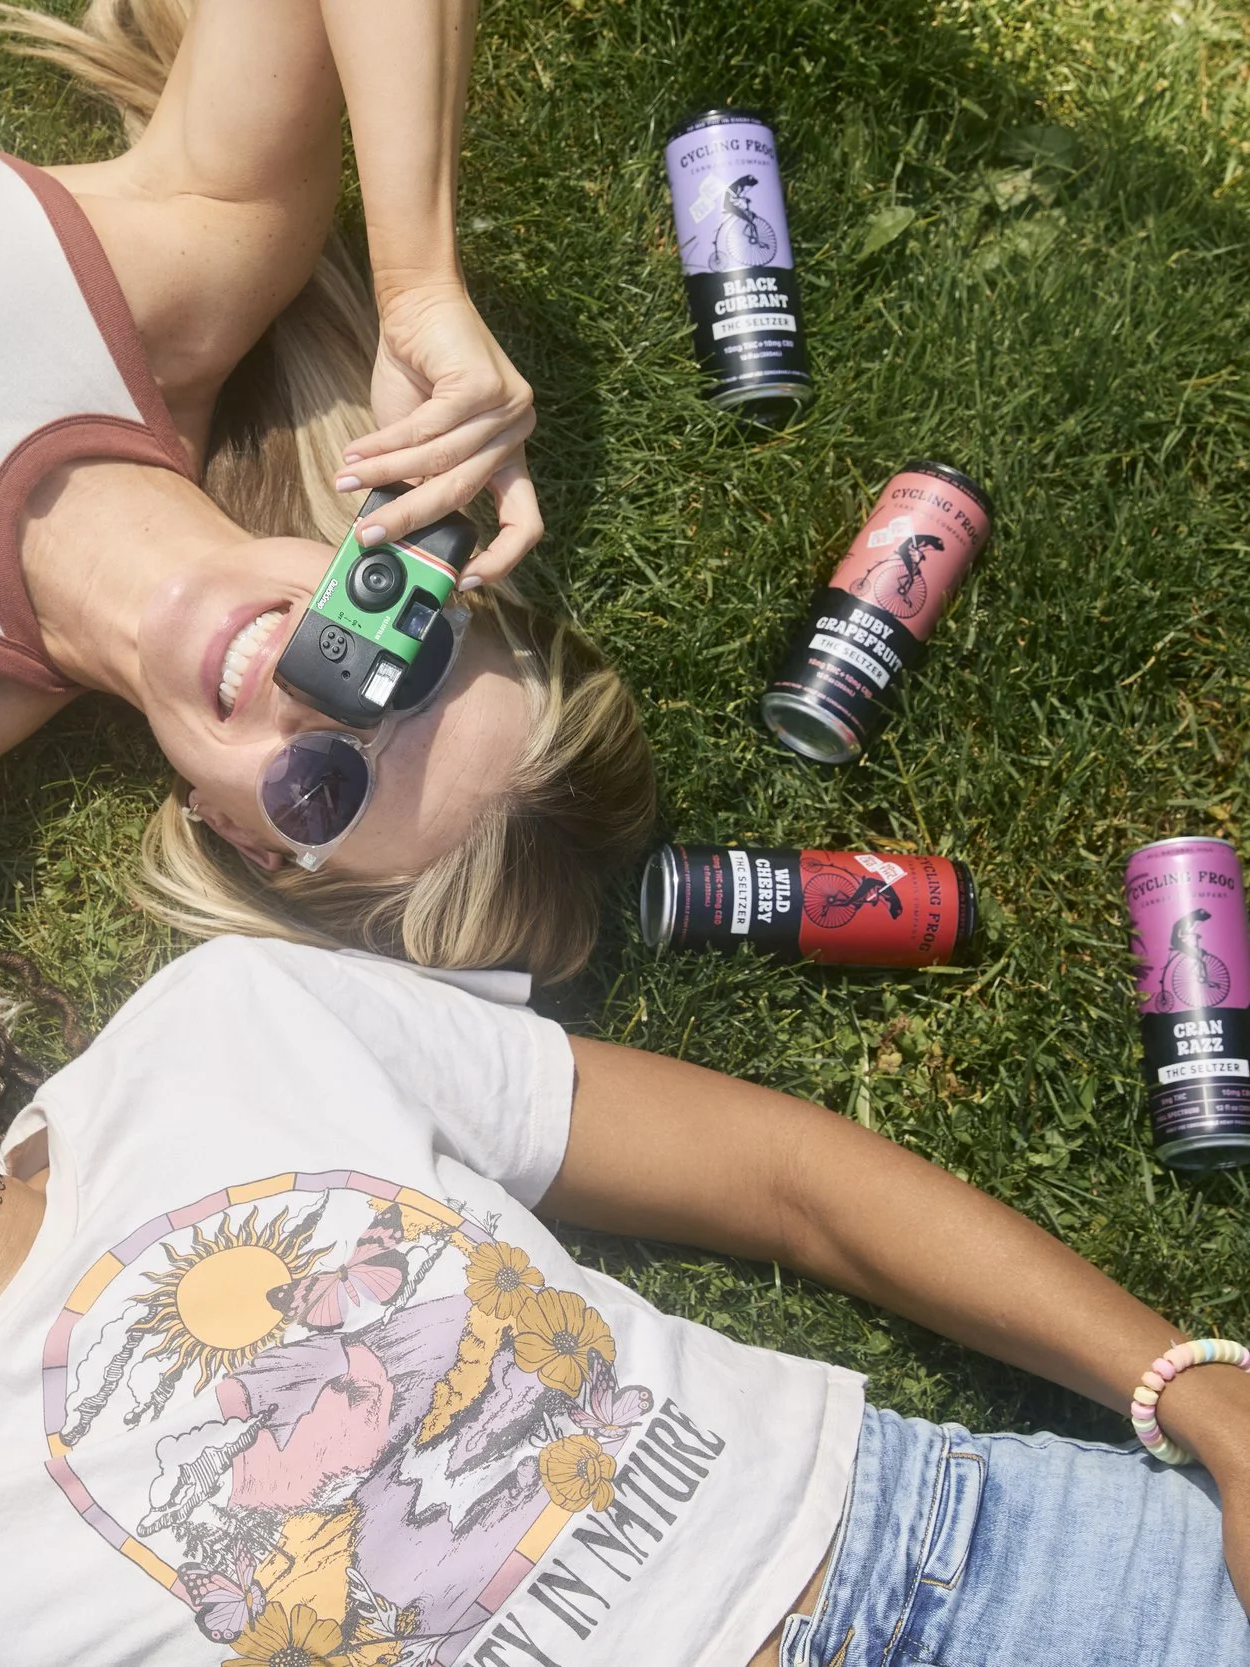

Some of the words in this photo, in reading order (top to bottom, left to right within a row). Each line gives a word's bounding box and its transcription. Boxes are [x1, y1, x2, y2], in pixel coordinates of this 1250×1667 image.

[680, 139, 740, 168] CYCLING
[723, 277, 778, 297] BLACK
[714, 294, 789, 315] CURRANT
[721, 321, 742, 333] THC
[746, 317, 790, 327] SELTZER
[891, 488, 953, 513] CYCLING
[316, 578, 339, 610] QuickSnap
[849, 608, 895, 640] RUBY
[816, 616, 903, 673] GRAPEFRUIT
[821, 638, 839, 650] THC
[843, 646, 884, 680] SELTZER
[735, 856, 746, 873] THC
[736, 875, 748, 925] SELTZER
[755, 858, 773, 924] CHERRY
[775, 868, 791, 913] WILD
[1132, 872, 1191, 900] CYCLING
[1198, 871, 1235, 890] FROG
[918, 912, 940, 952] FROG
[1173, 1019, 1223, 1038] CRAN
[1177, 1037, 1224, 1056] RAZZ
[1166, 1067, 1186, 1079] THC
[1190, 1063, 1240, 1075] SELTZER
[527, 1558, 610, 1641] IN
[572, 1397, 726, 1582] NATURE
